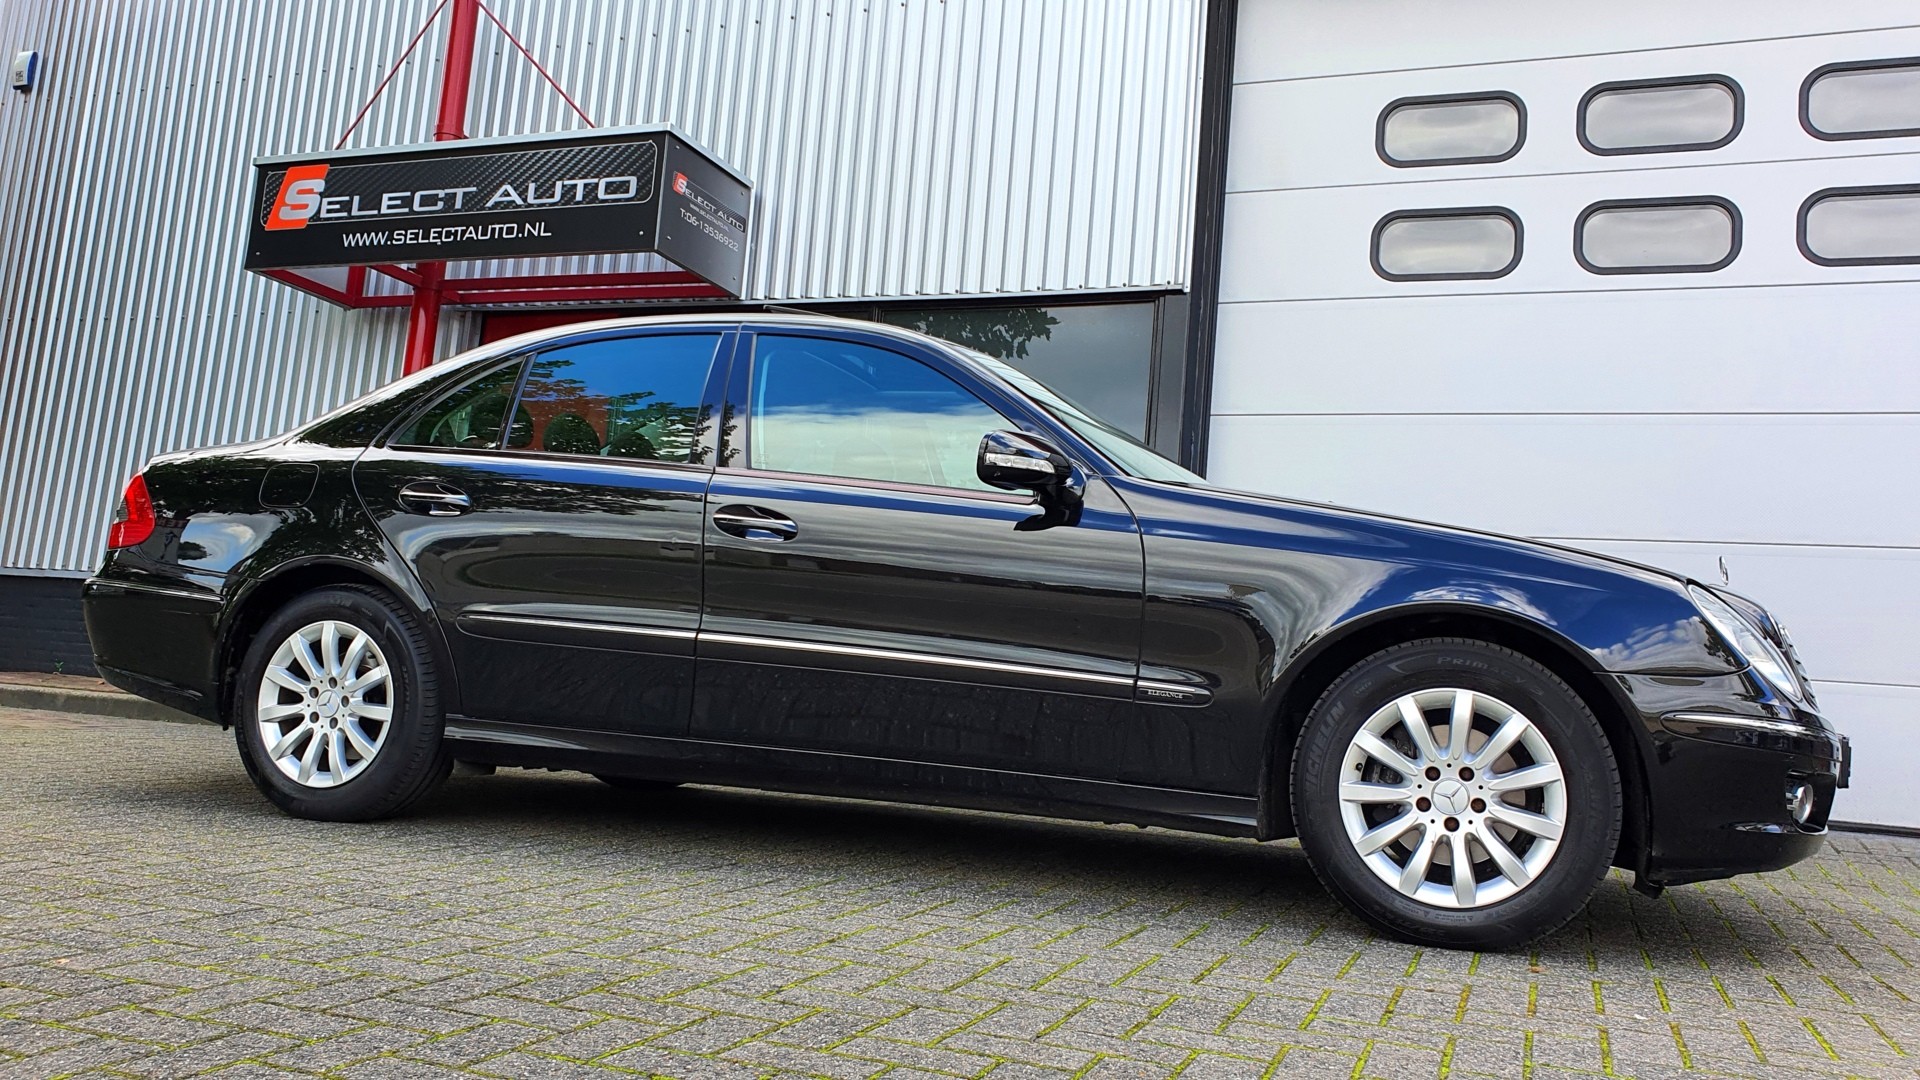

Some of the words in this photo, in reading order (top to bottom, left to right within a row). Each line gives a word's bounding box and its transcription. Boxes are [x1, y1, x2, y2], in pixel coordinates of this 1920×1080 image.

[485, 175, 637, 208] AUTO
[717, 211, 744, 231] AUTO
[342, 221, 552, 248] WWW.SELECTAUTO.NL
[1147, 689, 1183, 699] ELEGANCE
